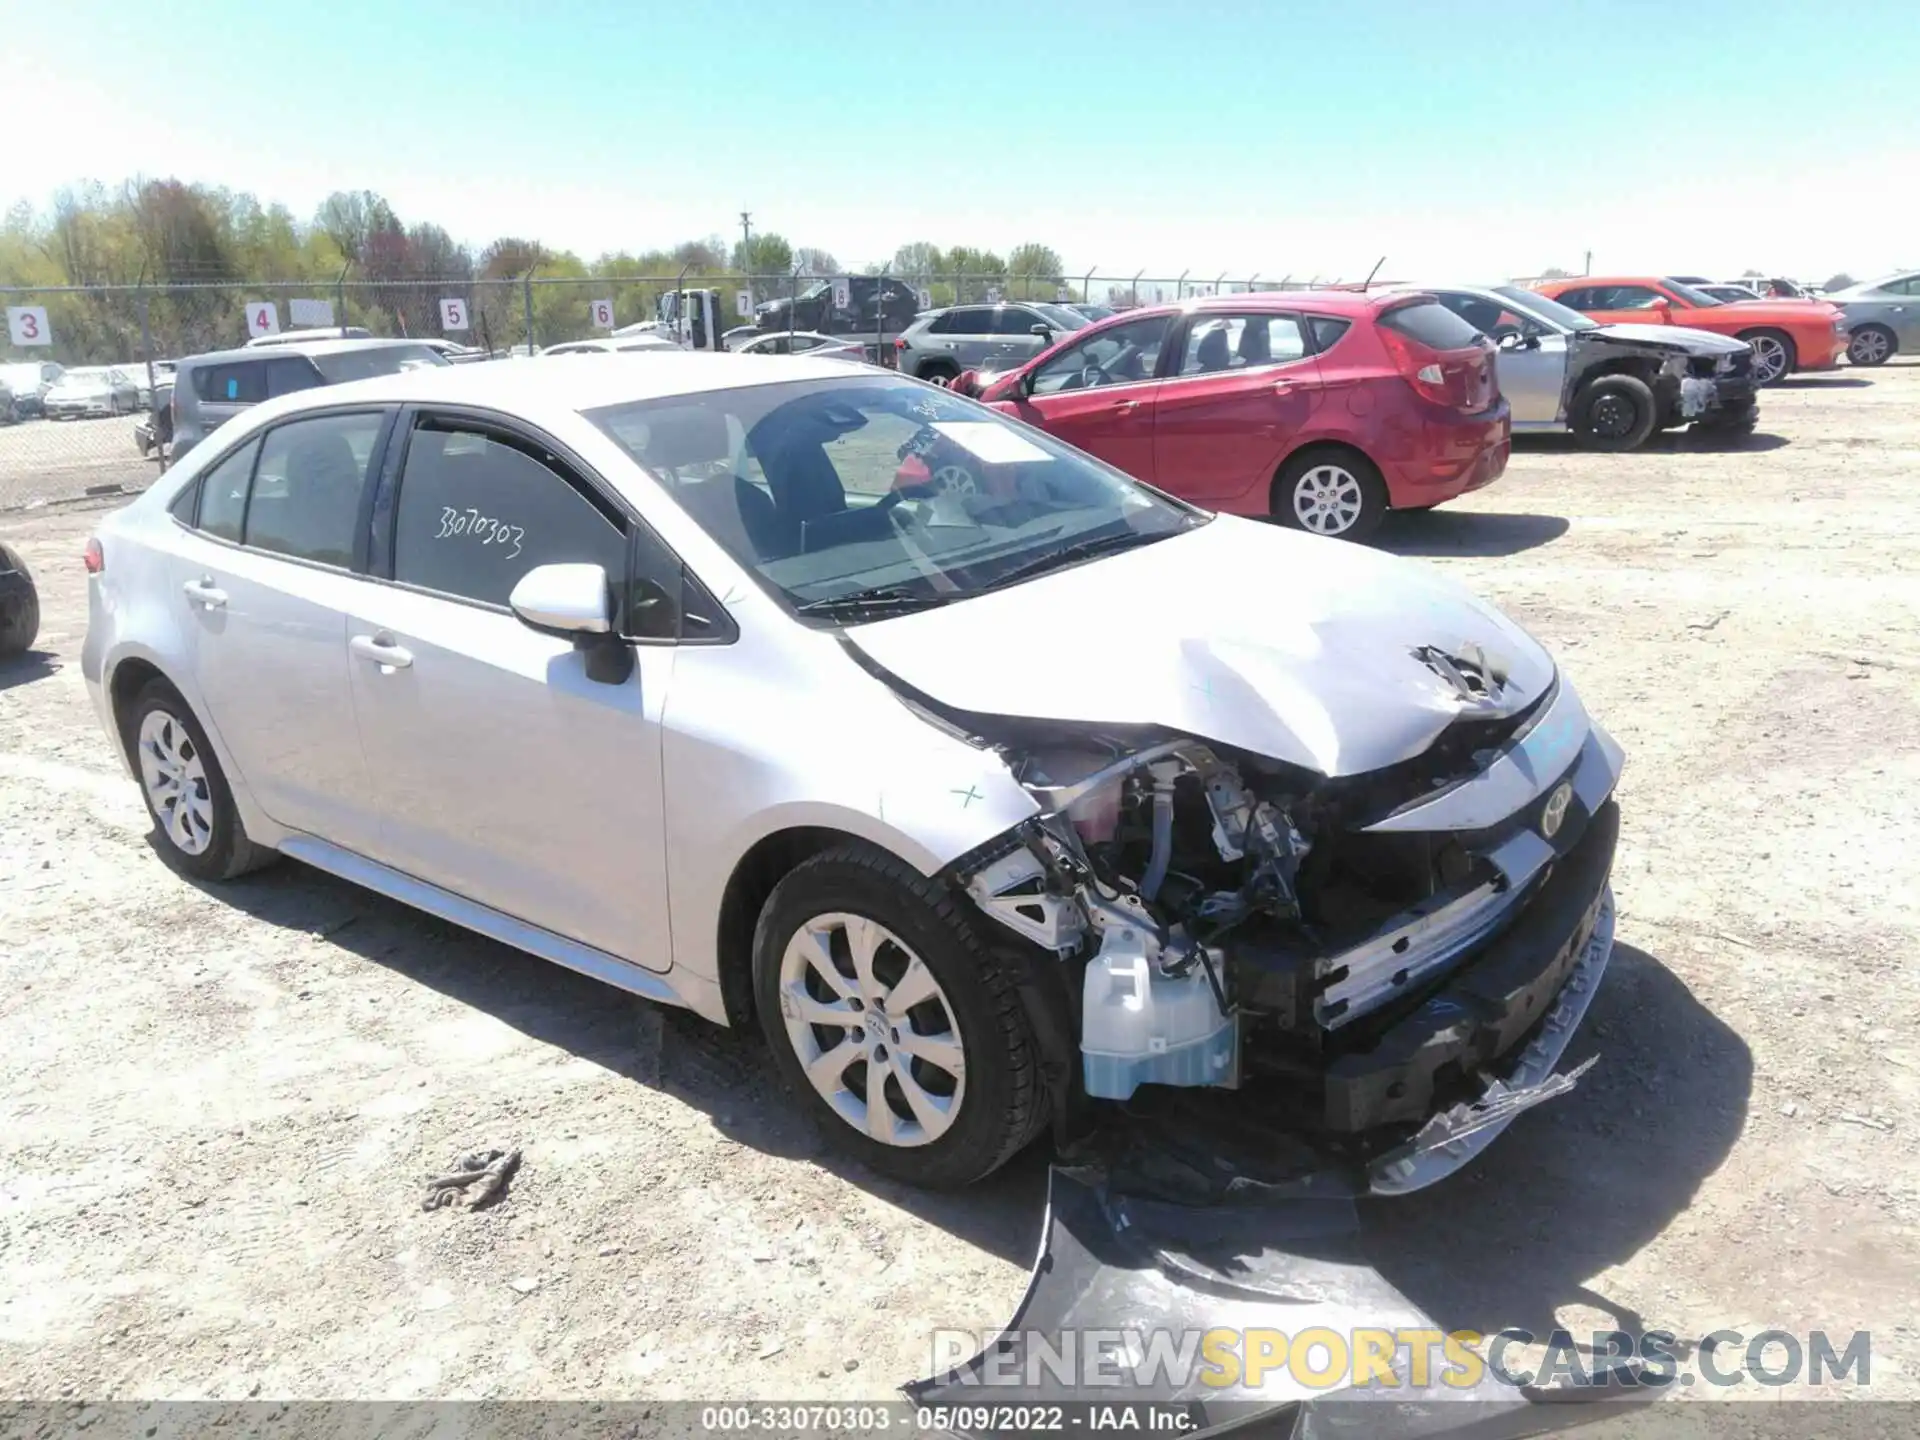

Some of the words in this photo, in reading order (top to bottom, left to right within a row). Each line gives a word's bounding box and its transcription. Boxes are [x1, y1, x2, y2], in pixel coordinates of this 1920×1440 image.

[598, 304, 609, 323] 6
[739, 295, 748, 311] 7
[256, 309, 270, 330] 4
[447, 304, 460, 325] 5
[20, 313, 39, 339] 3
[433, 506, 525, 560] 33070303
